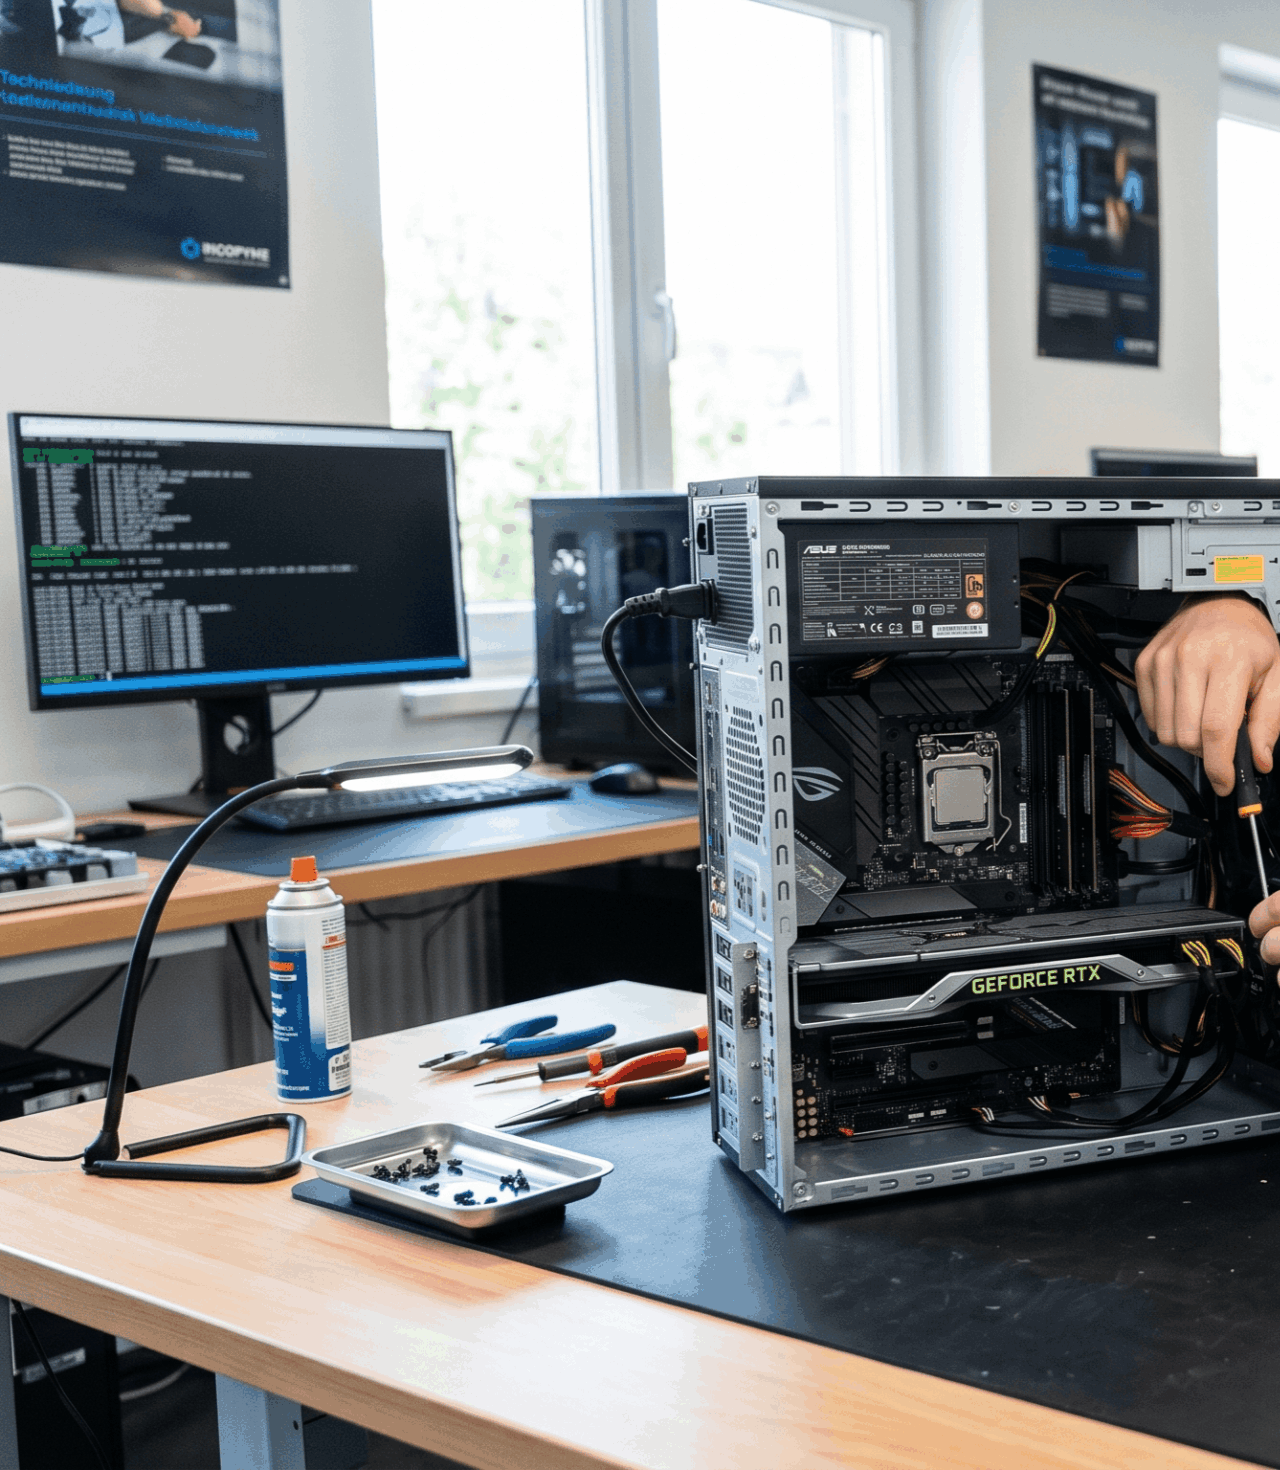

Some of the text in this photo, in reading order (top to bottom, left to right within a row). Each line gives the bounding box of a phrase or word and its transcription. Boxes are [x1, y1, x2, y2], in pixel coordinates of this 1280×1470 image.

[803, 545, 838, 555] ASUS
[972, 964, 1101, 994] GEFORCE RTX
